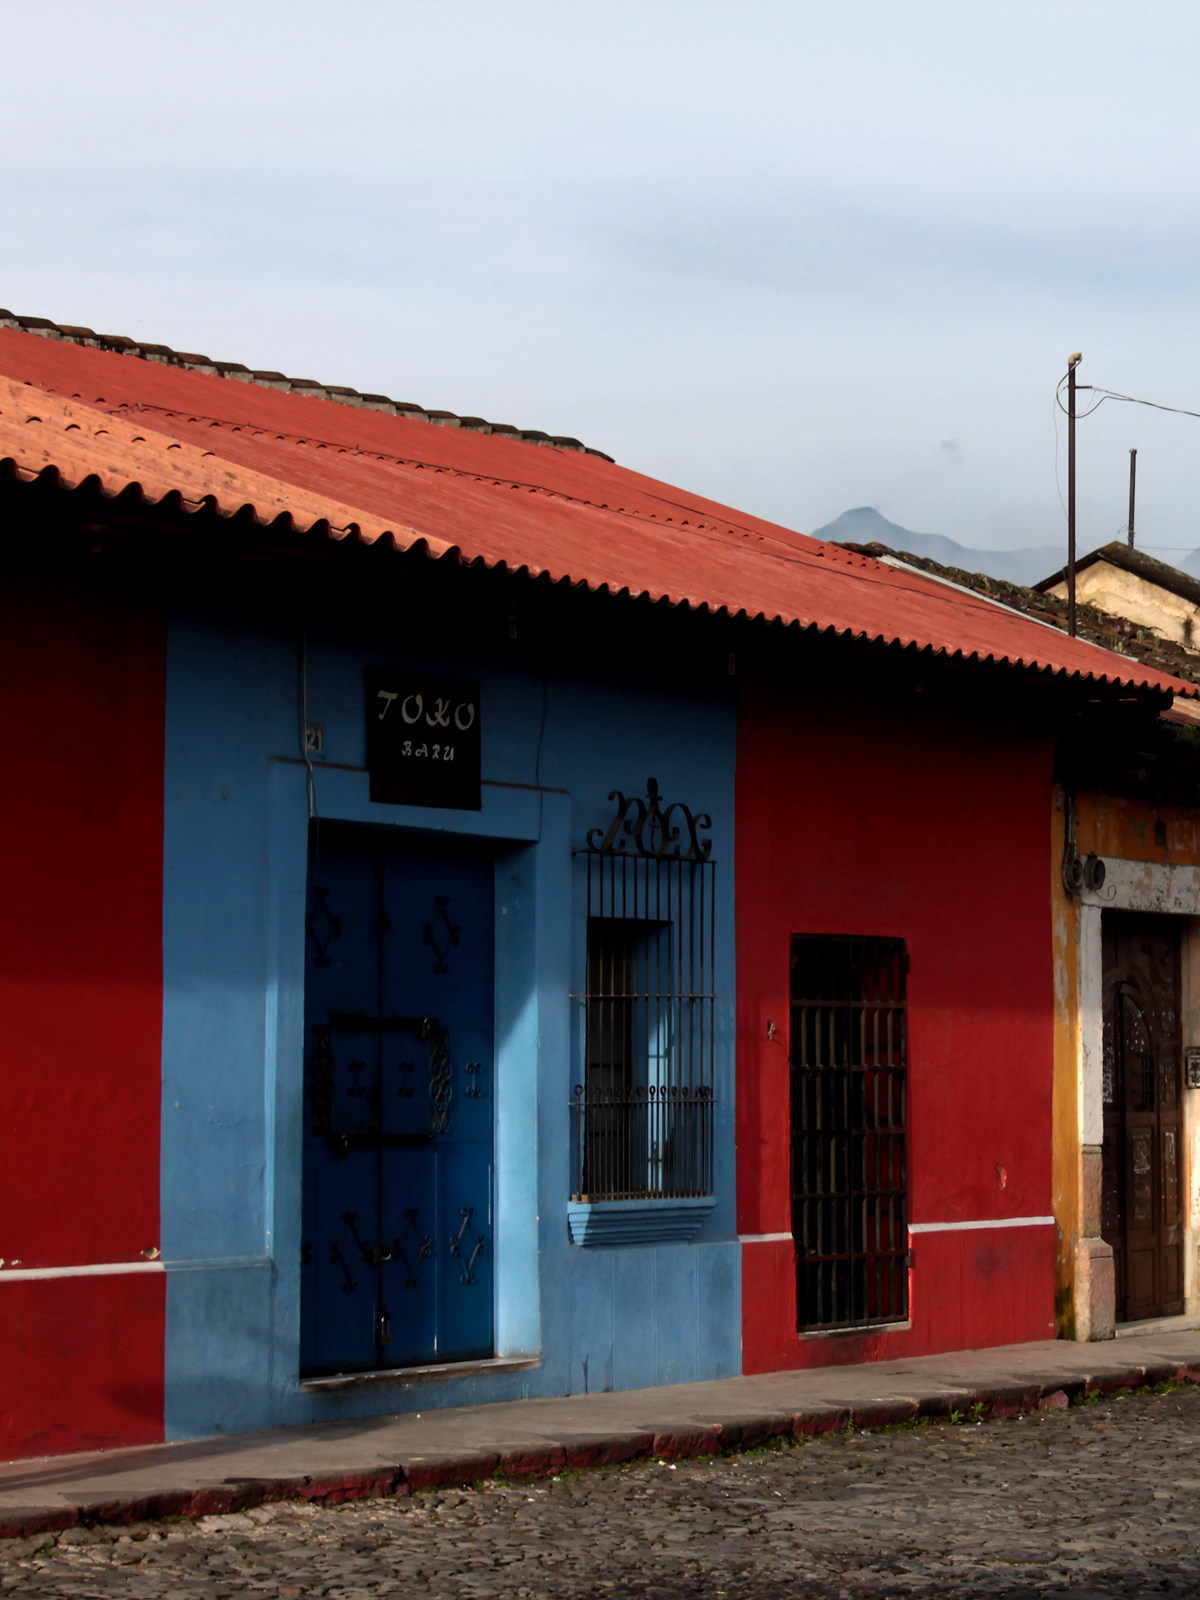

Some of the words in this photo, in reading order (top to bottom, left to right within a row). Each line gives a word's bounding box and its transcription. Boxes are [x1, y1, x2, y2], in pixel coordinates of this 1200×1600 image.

[377, 689, 475, 731] TOKO
[306, 728, 322, 751] 21
[401, 740, 455, 761] BARU
